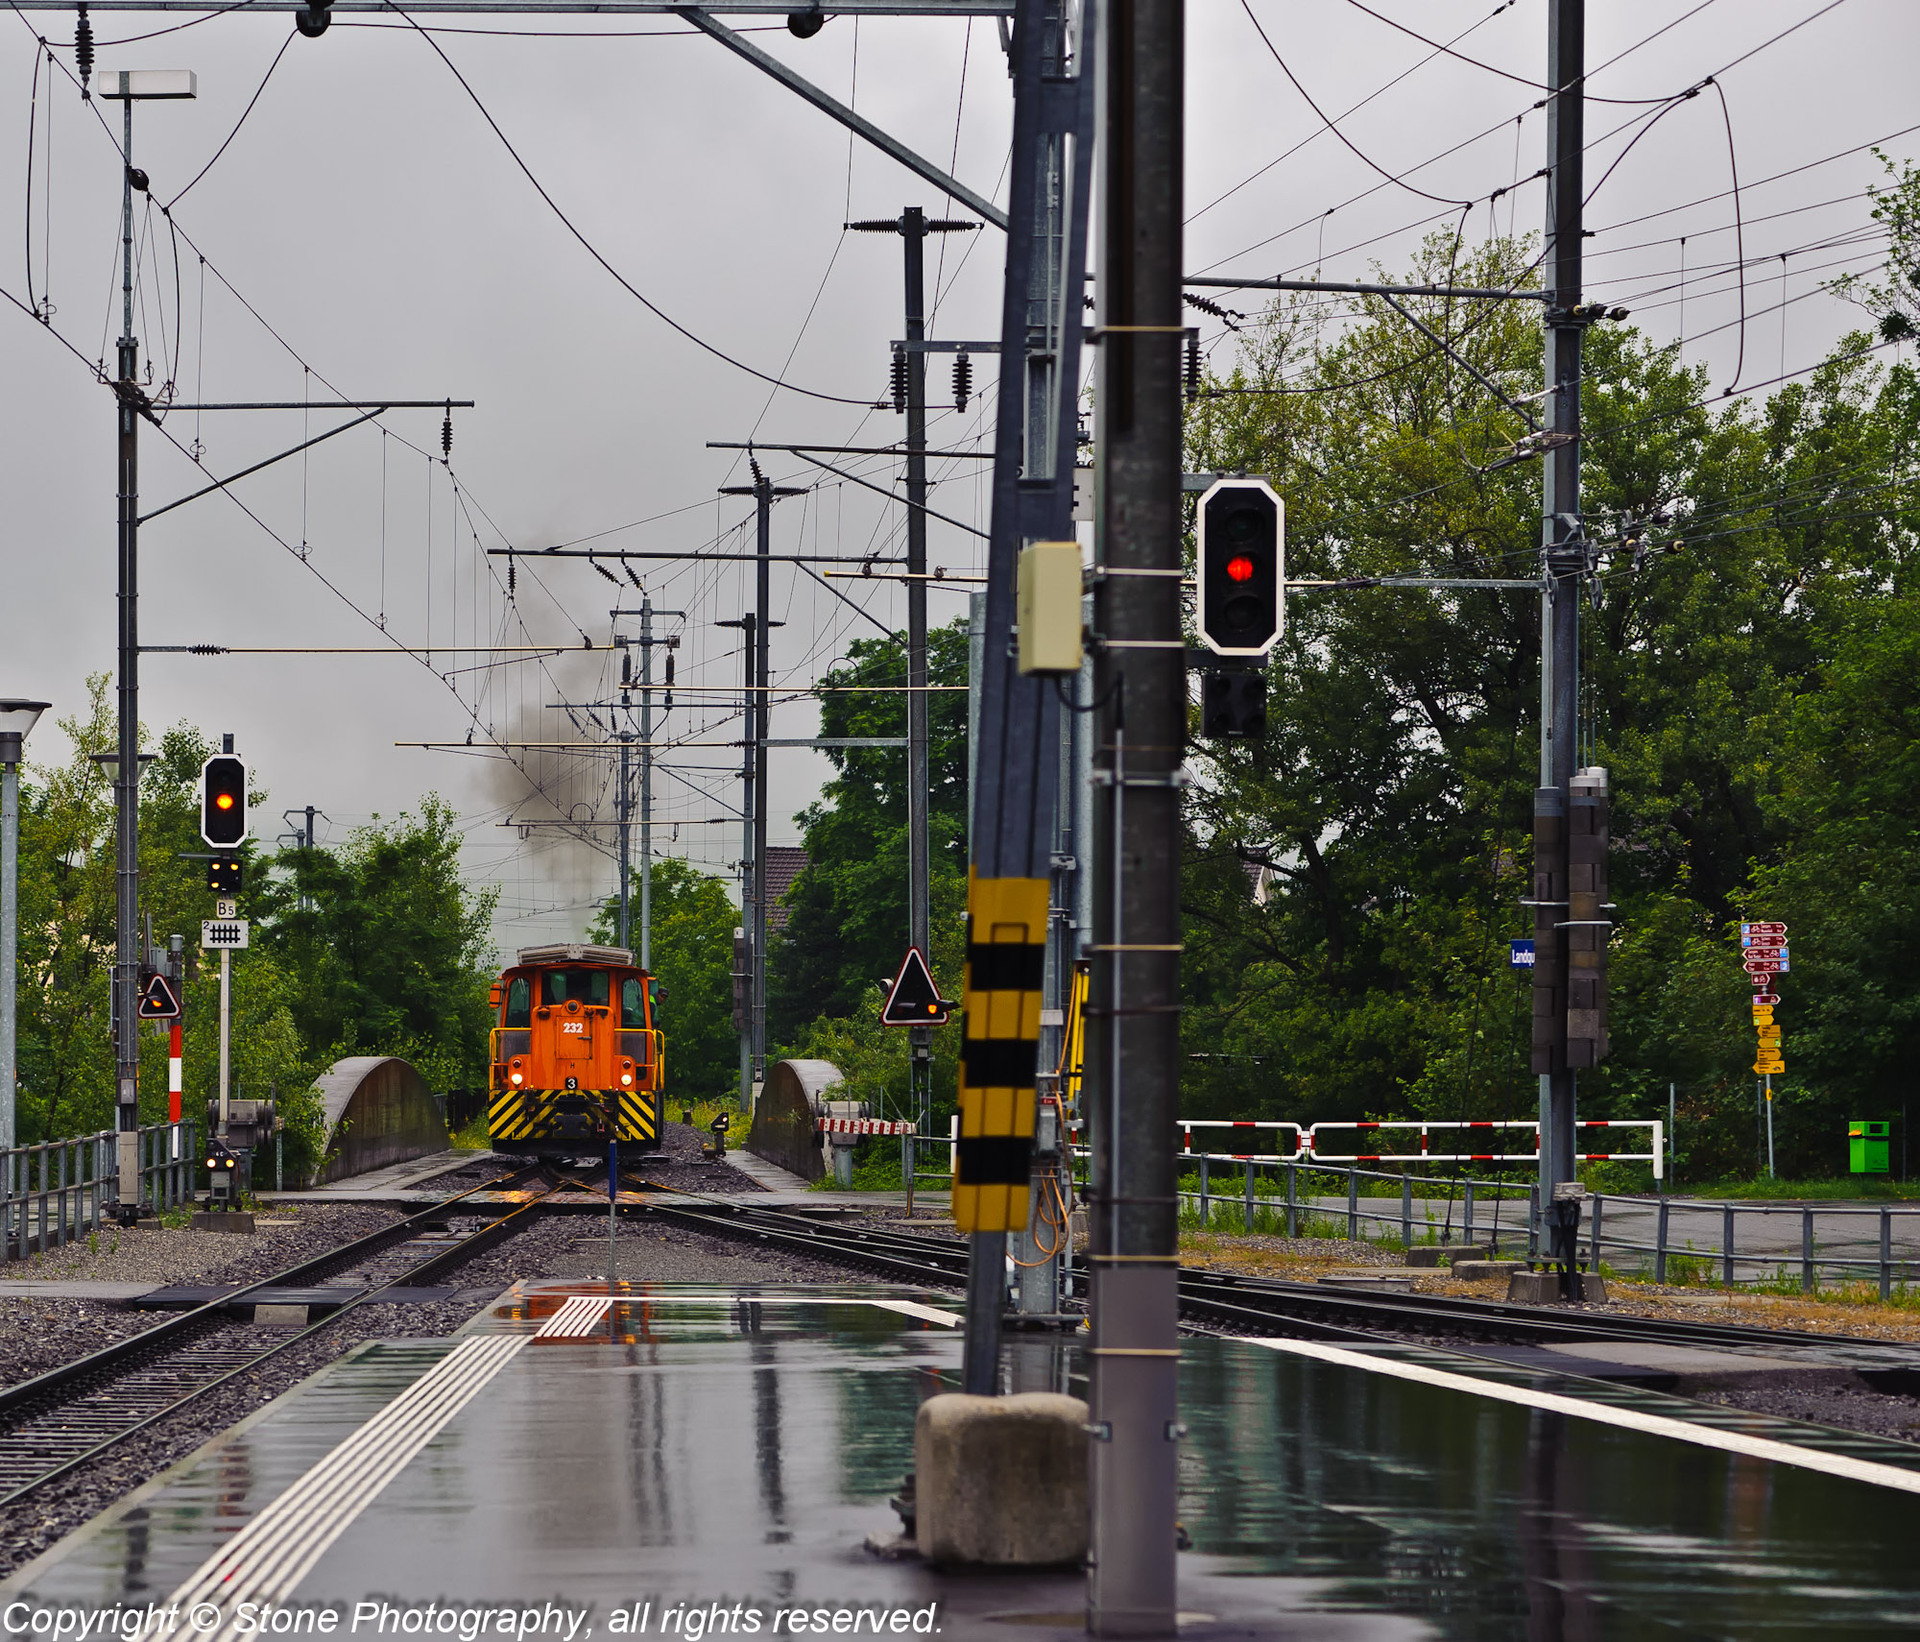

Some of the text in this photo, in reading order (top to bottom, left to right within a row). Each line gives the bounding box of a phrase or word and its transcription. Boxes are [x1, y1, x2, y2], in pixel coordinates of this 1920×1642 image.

[218, 901, 234, 916] B5
[203, 920, 210, 930] 2
[563, 1022, 584, 1034] 232
[567, 1078, 576, 1090] 3
